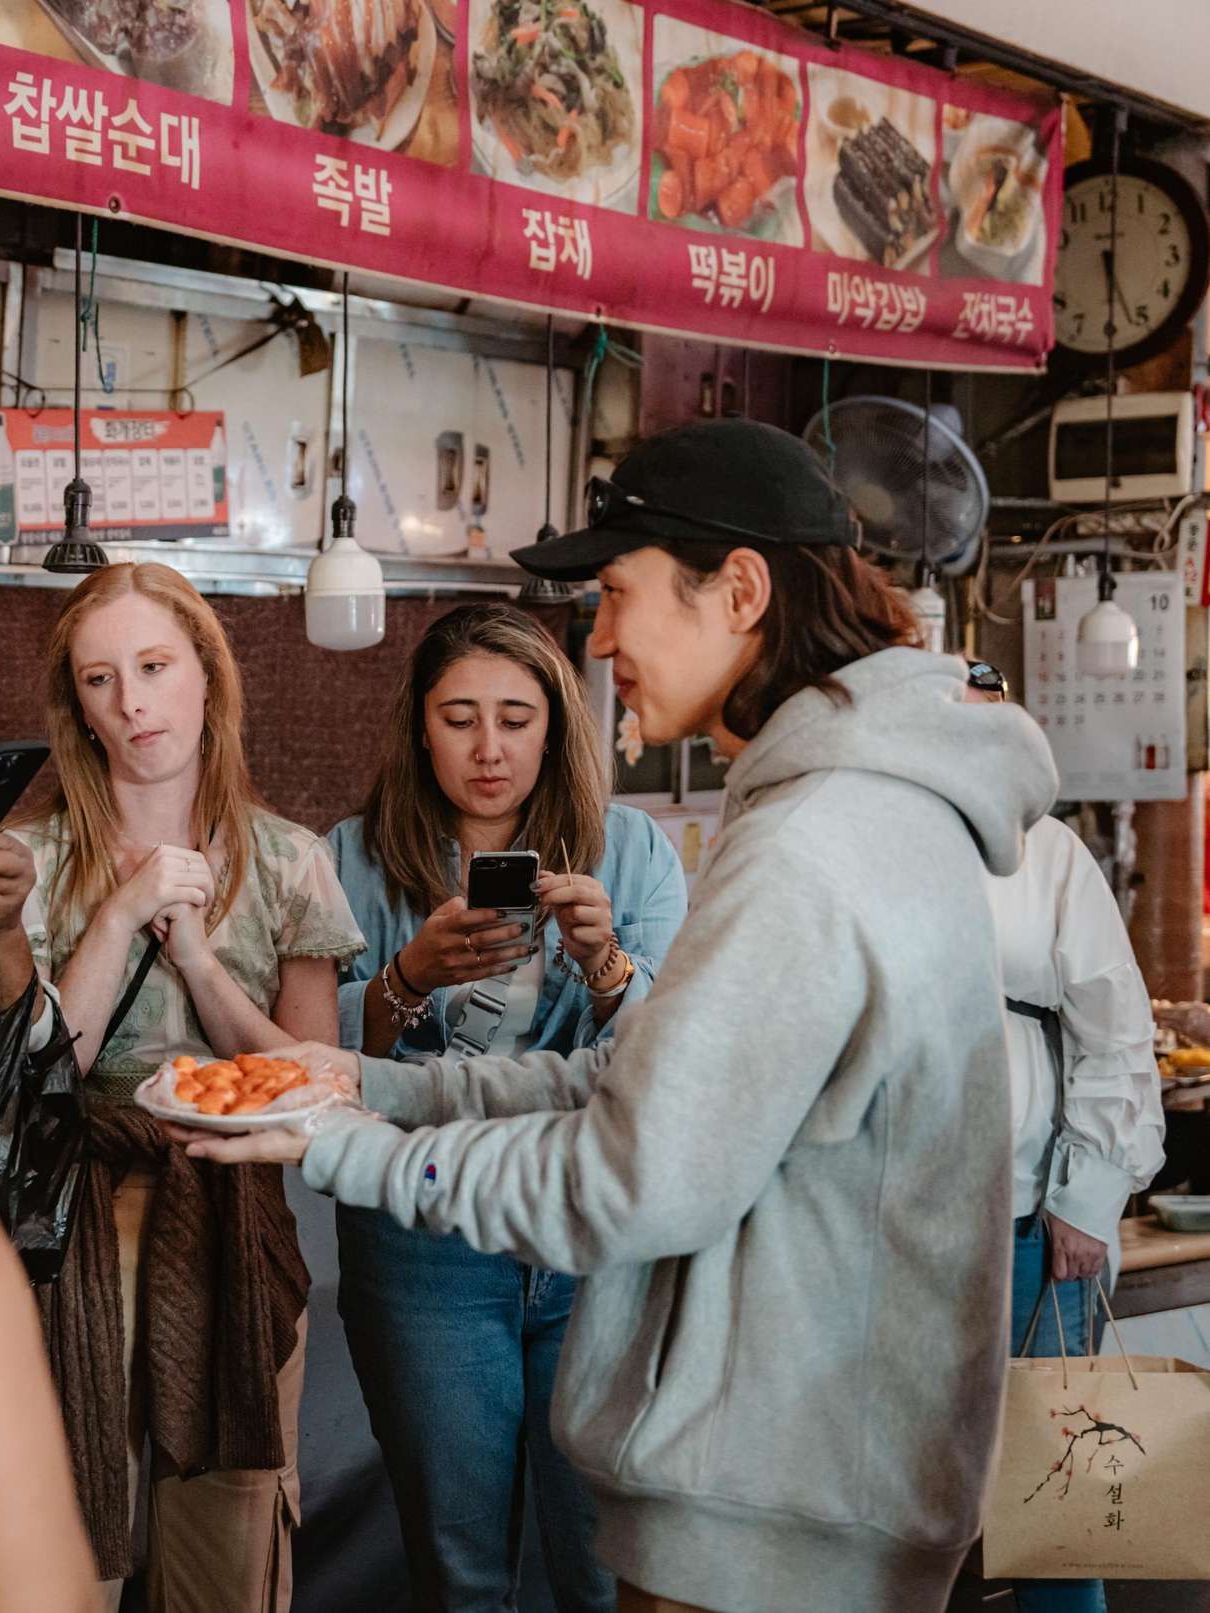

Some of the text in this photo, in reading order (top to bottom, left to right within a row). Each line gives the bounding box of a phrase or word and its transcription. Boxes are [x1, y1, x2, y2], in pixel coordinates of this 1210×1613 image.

[3, 72, 200, 190] 찹쌀순대
[312, 154, 392, 236] 족발
[1158, 213, 1171, 235] 2
[522, 208, 592, 280] 잡채
[688, 244, 775, 313] 떡볶이
[1165, 245, 1180, 267] 3
[1150, 593, 1170, 612] 10
[1103, 1454, 1125, 1531] 수설화
